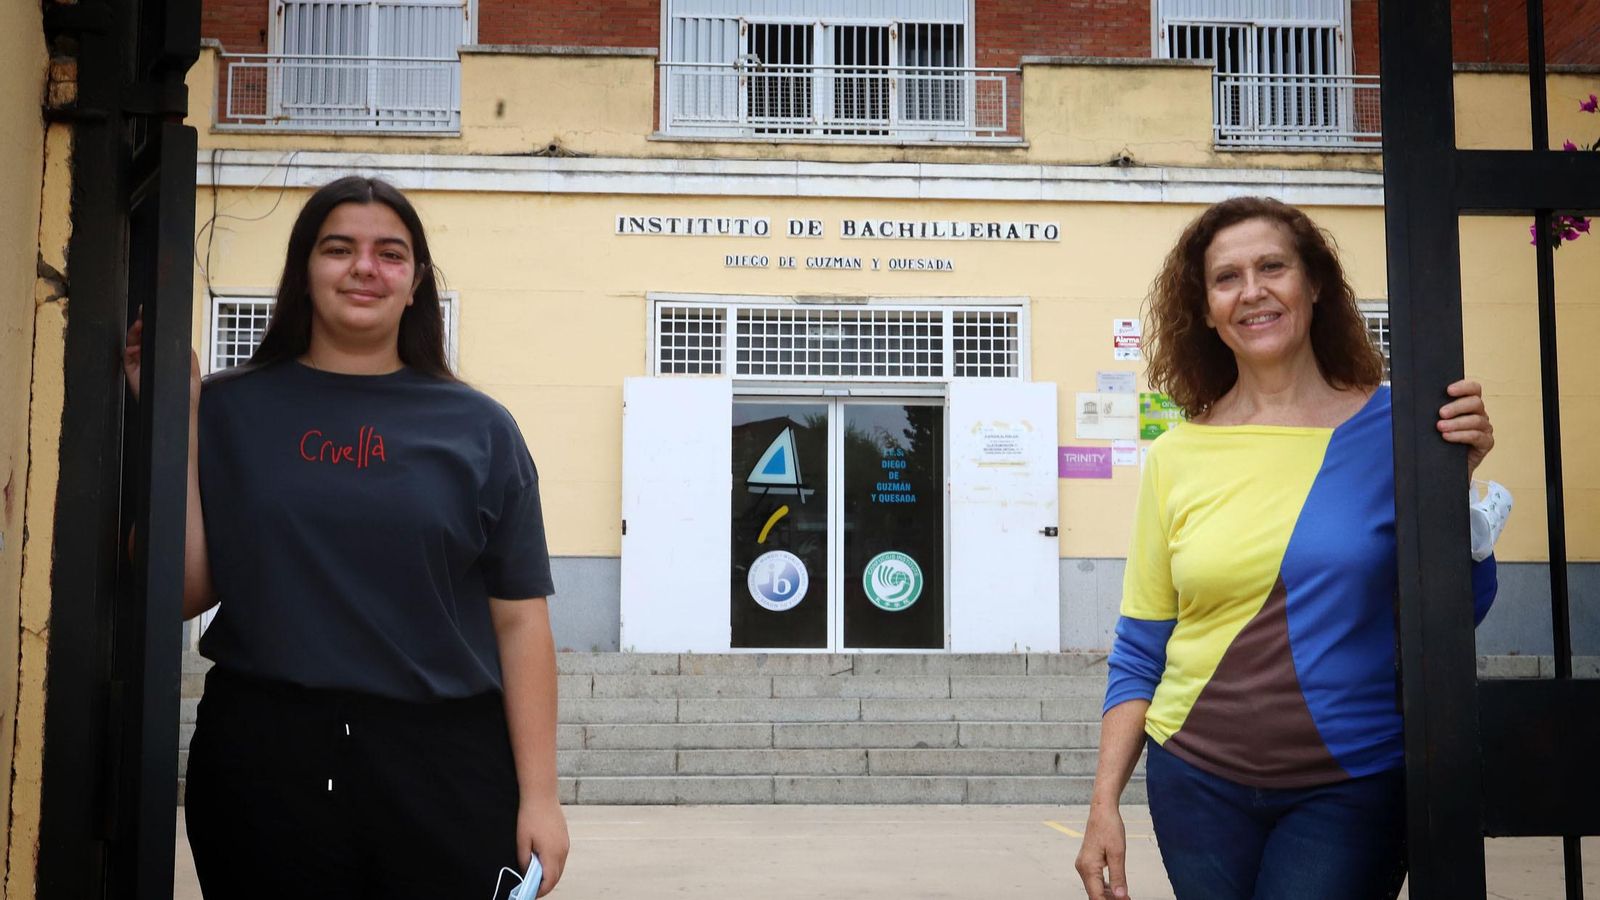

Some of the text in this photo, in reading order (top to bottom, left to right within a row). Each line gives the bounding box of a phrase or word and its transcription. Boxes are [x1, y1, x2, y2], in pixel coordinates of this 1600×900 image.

[617, 216, 1059, 241] INSTITUTO DE BACHILLERATO
[725, 255, 953, 270] DIEGO DE GUZMAN Y QUESADA
[300, 425, 386, 468] Cruella
[1063, 453, 1106, 464] TRINITY
[881, 460, 907, 469] DIEGO
[888, 471, 900, 480] DE
[871, 494, 917, 503] Y QUESADA
